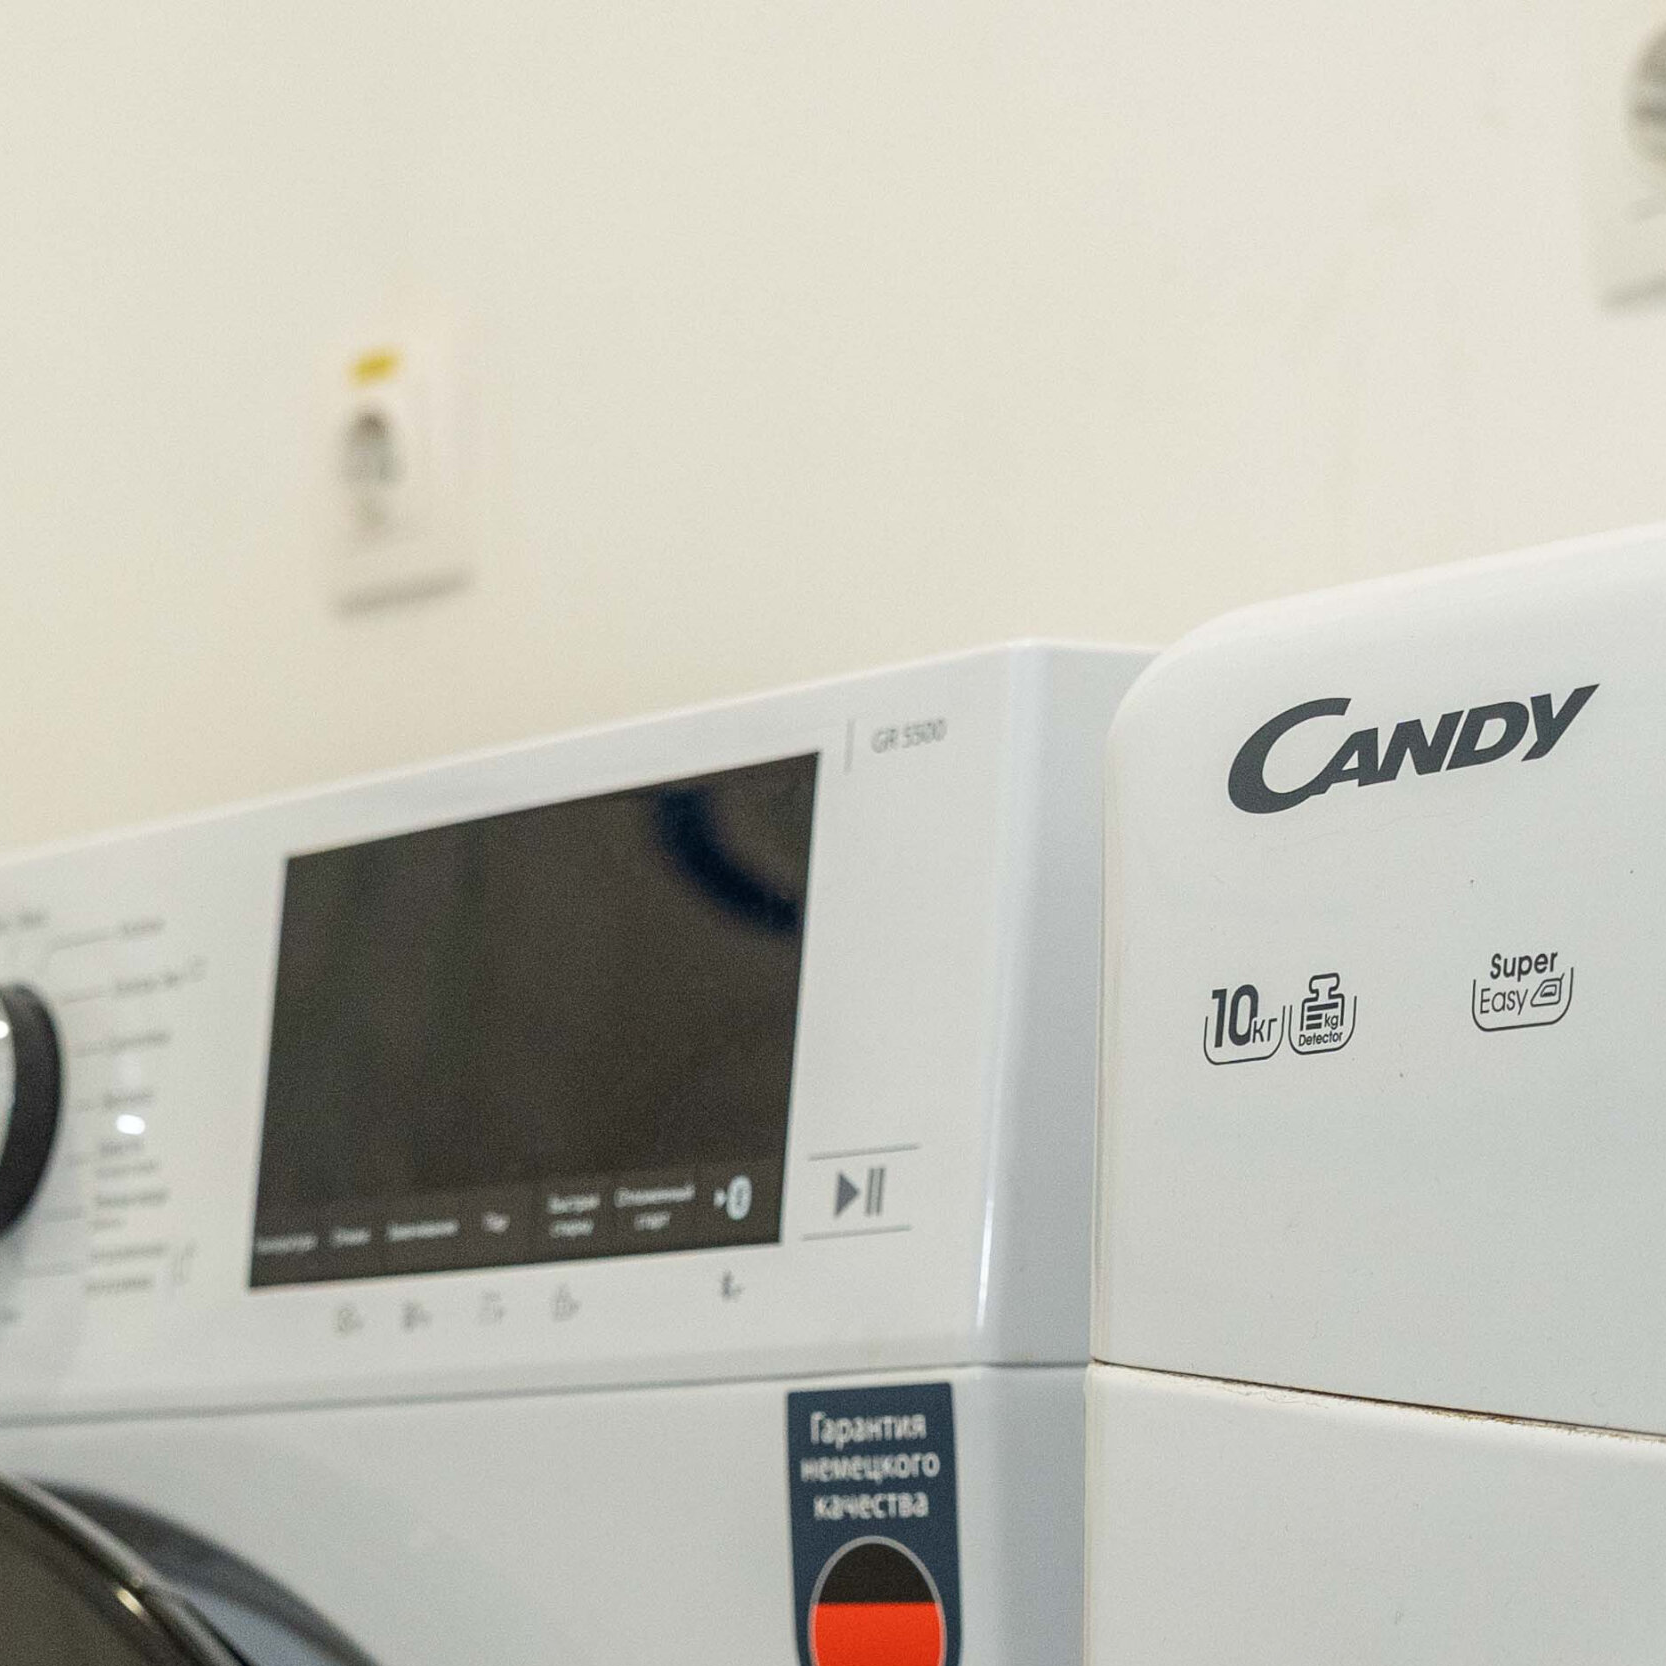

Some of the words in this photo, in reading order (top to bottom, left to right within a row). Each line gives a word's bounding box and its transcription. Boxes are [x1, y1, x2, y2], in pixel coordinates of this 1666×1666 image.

[1228, 684, 1600, 814] CANDY
[1490, 952, 1558, 982] Super
[1480, 988, 1529, 1016] Easy
[1324, 1013, 1340, 1030] kg
[1298, 1030, 1343, 1047] Detector
[810, 1411, 927, 1451] Гарантия
[800, 1451, 940, 1485] немецкого
[814, 1491, 929, 1520] качества
